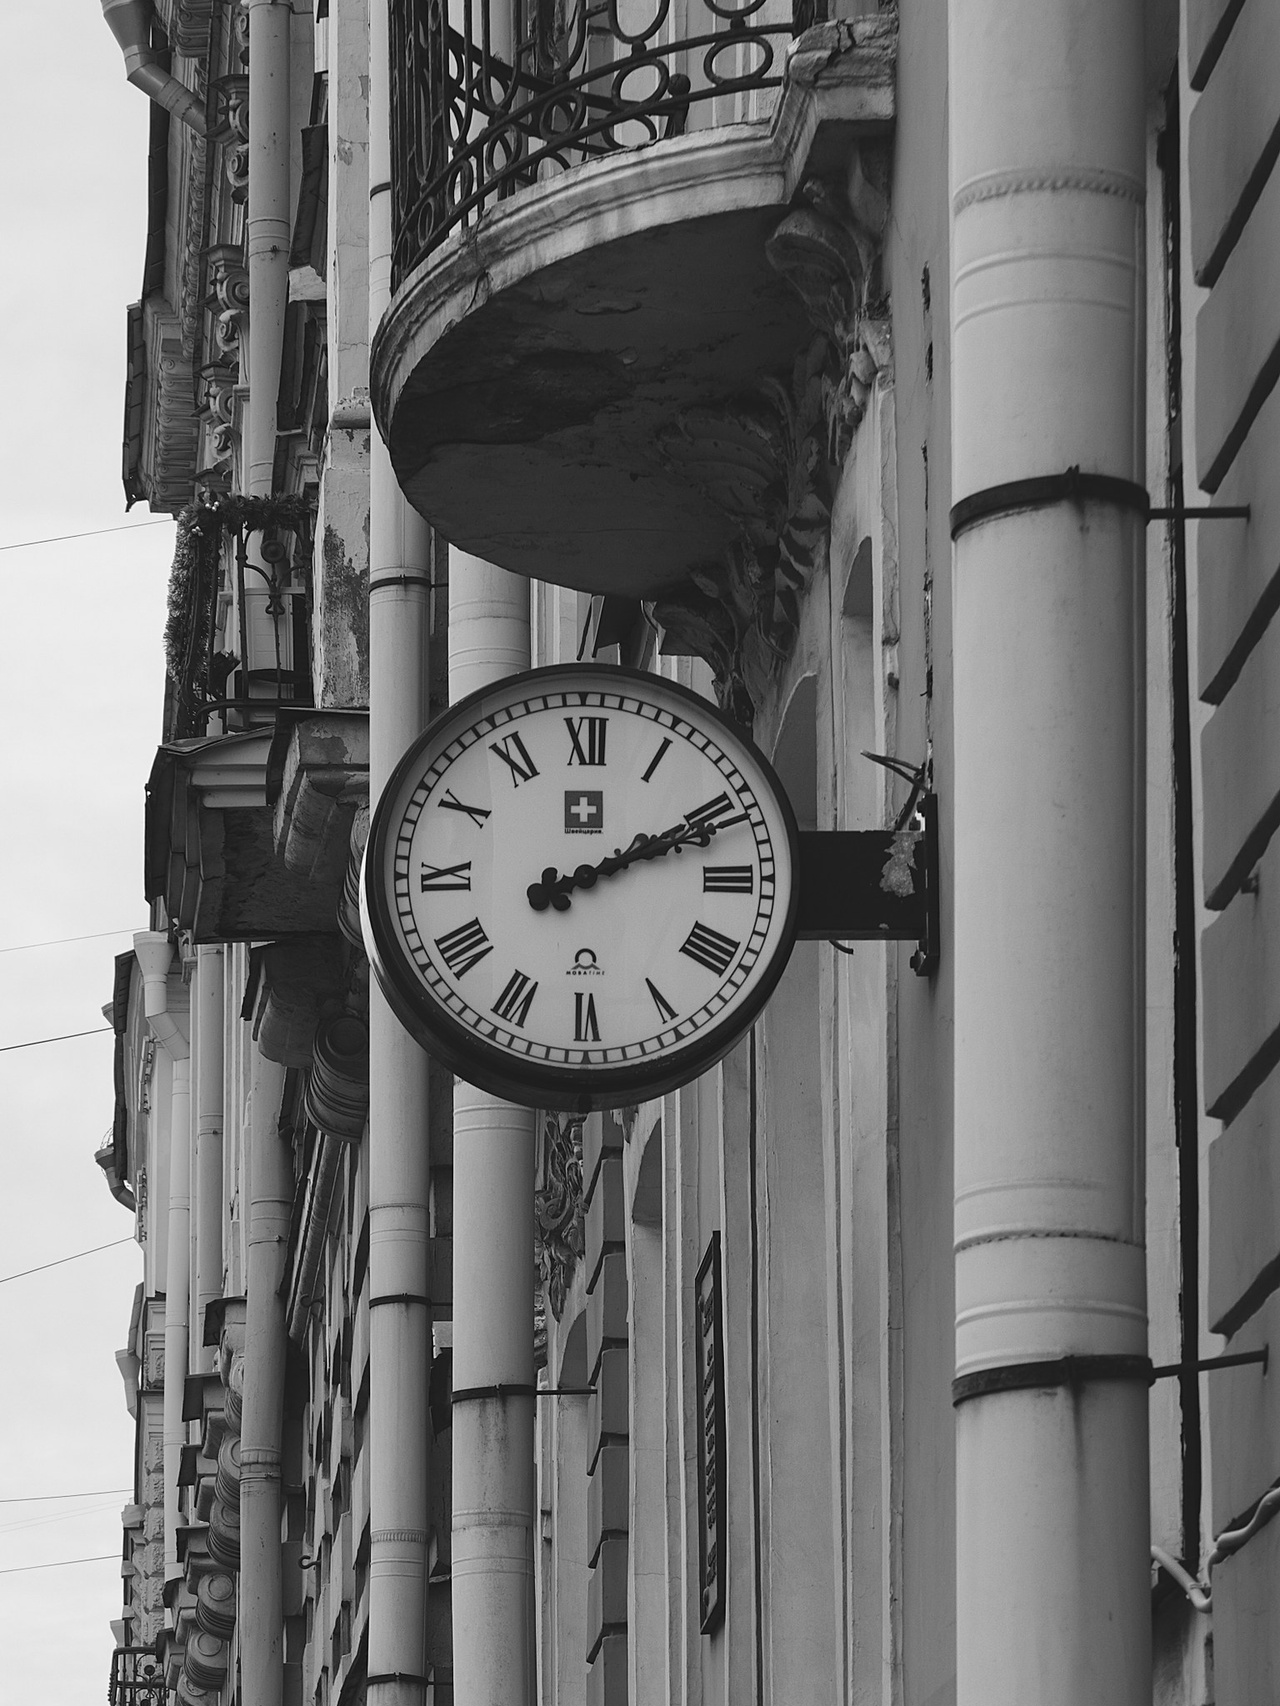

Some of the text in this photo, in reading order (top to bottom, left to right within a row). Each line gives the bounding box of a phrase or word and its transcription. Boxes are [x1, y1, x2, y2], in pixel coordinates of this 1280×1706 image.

[489, 731, 540, 788] XI
[563, 717, 609, 766] XII
[641, 737, 673, 783] I
[438, 788, 492, 829] X
[421, 861, 471, 893] IX
[703, 864, 753, 894] III
[434, 917, 494, 980] VIII
[490, 969, 538, 1028] VII
[573, 992, 601, 1042] VI
[645, 977, 680, 1024] V
